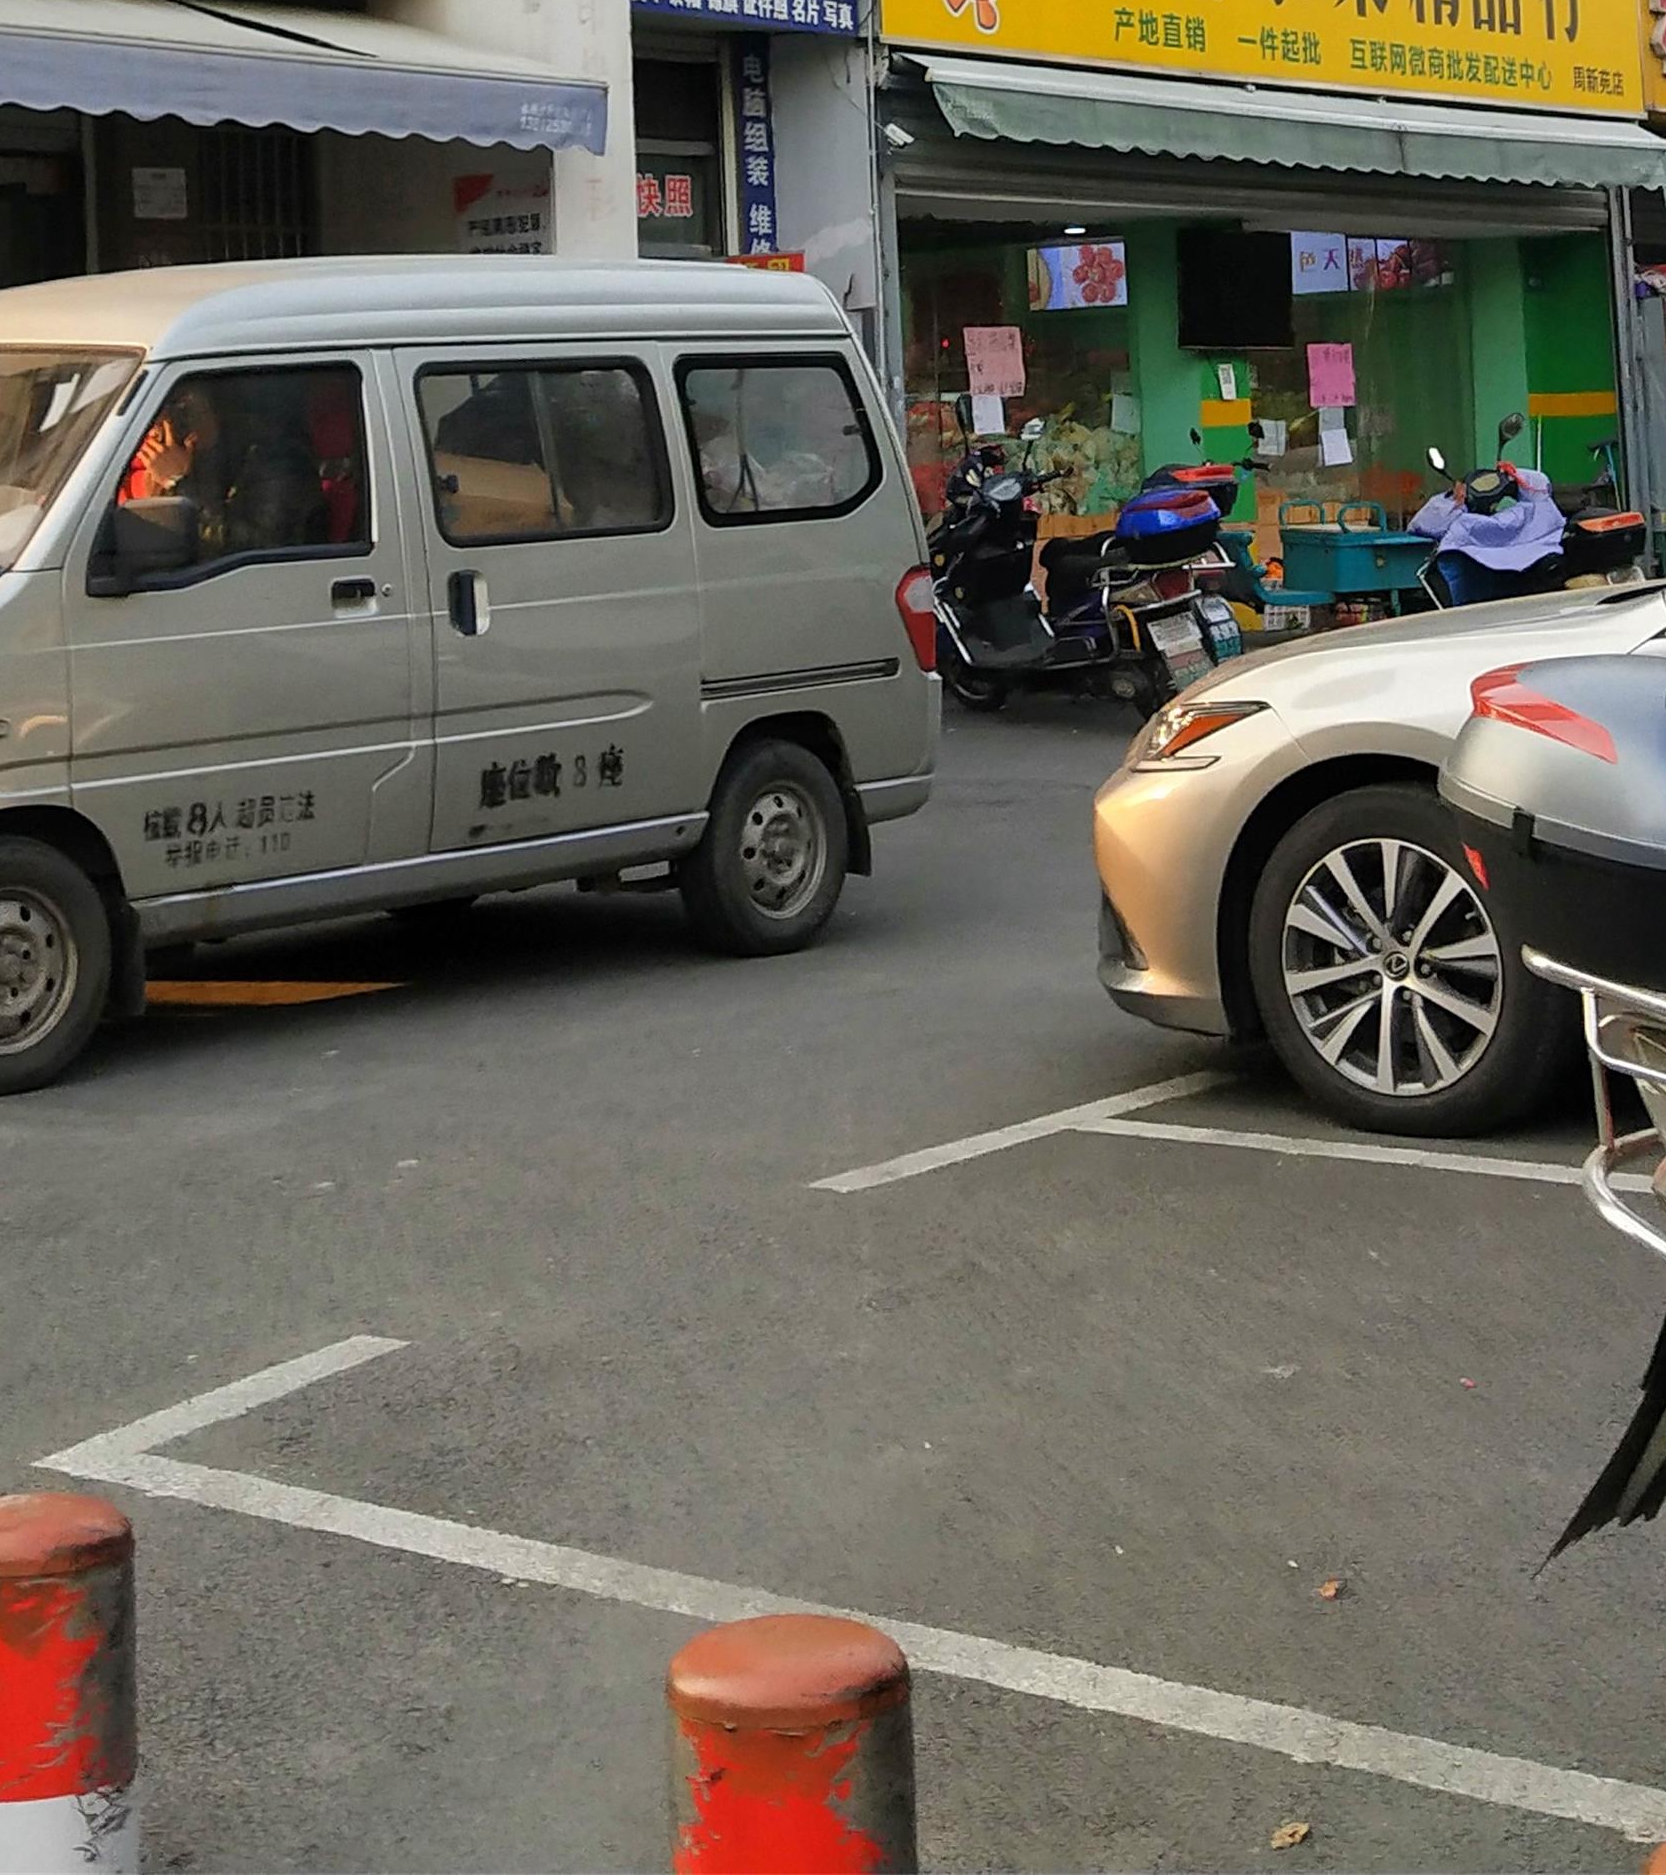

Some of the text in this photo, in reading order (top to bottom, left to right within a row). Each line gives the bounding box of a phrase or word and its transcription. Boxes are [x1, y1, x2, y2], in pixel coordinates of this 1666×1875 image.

[1113, 6, 1207, 53] 产地直销
[1236, 28, 1323, 67] 一件起批
[1349, 38, 1553, 92] 互联网微商批发配送中心
